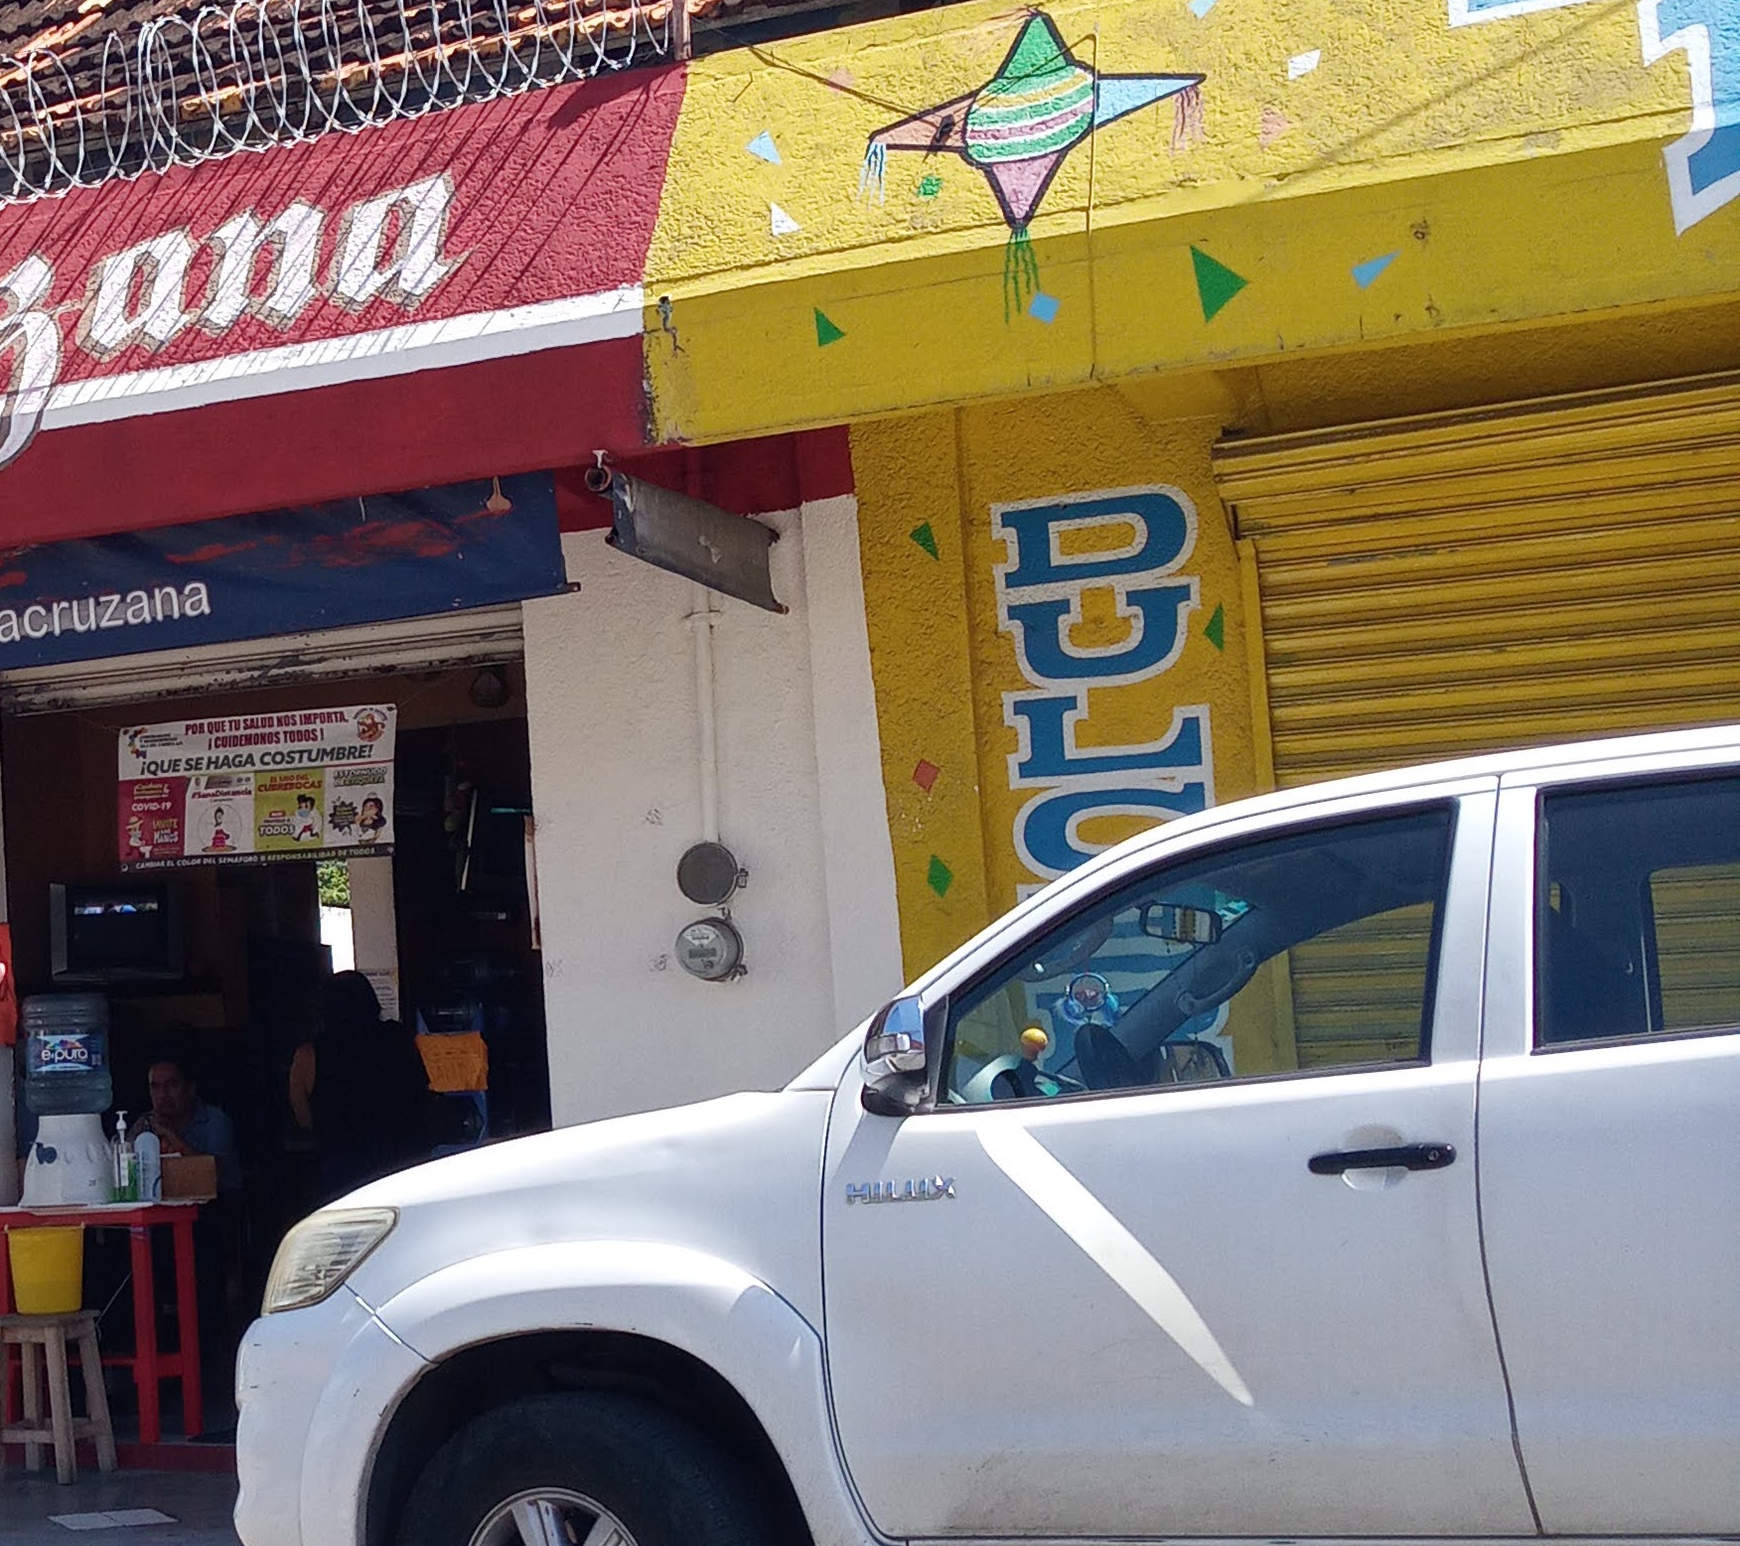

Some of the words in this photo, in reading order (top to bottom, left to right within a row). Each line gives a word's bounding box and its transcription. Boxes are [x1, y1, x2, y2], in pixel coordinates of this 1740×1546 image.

[185, 724, 206, 736] POR
[207, 721, 227, 735] QUE
[228, 719, 240, 732] TU
[242, 716, 275, 730] SALUD
[276, 714, 298, 728] NOS
[282, 728, 319, 744] TODOS
[140, 760, 182, 776] ¡QUE
[183, 756, 204, 772] SE
[205, 752, 256, 771] HAGA
[259, 744, 375, 767] COSTUMBRE!
